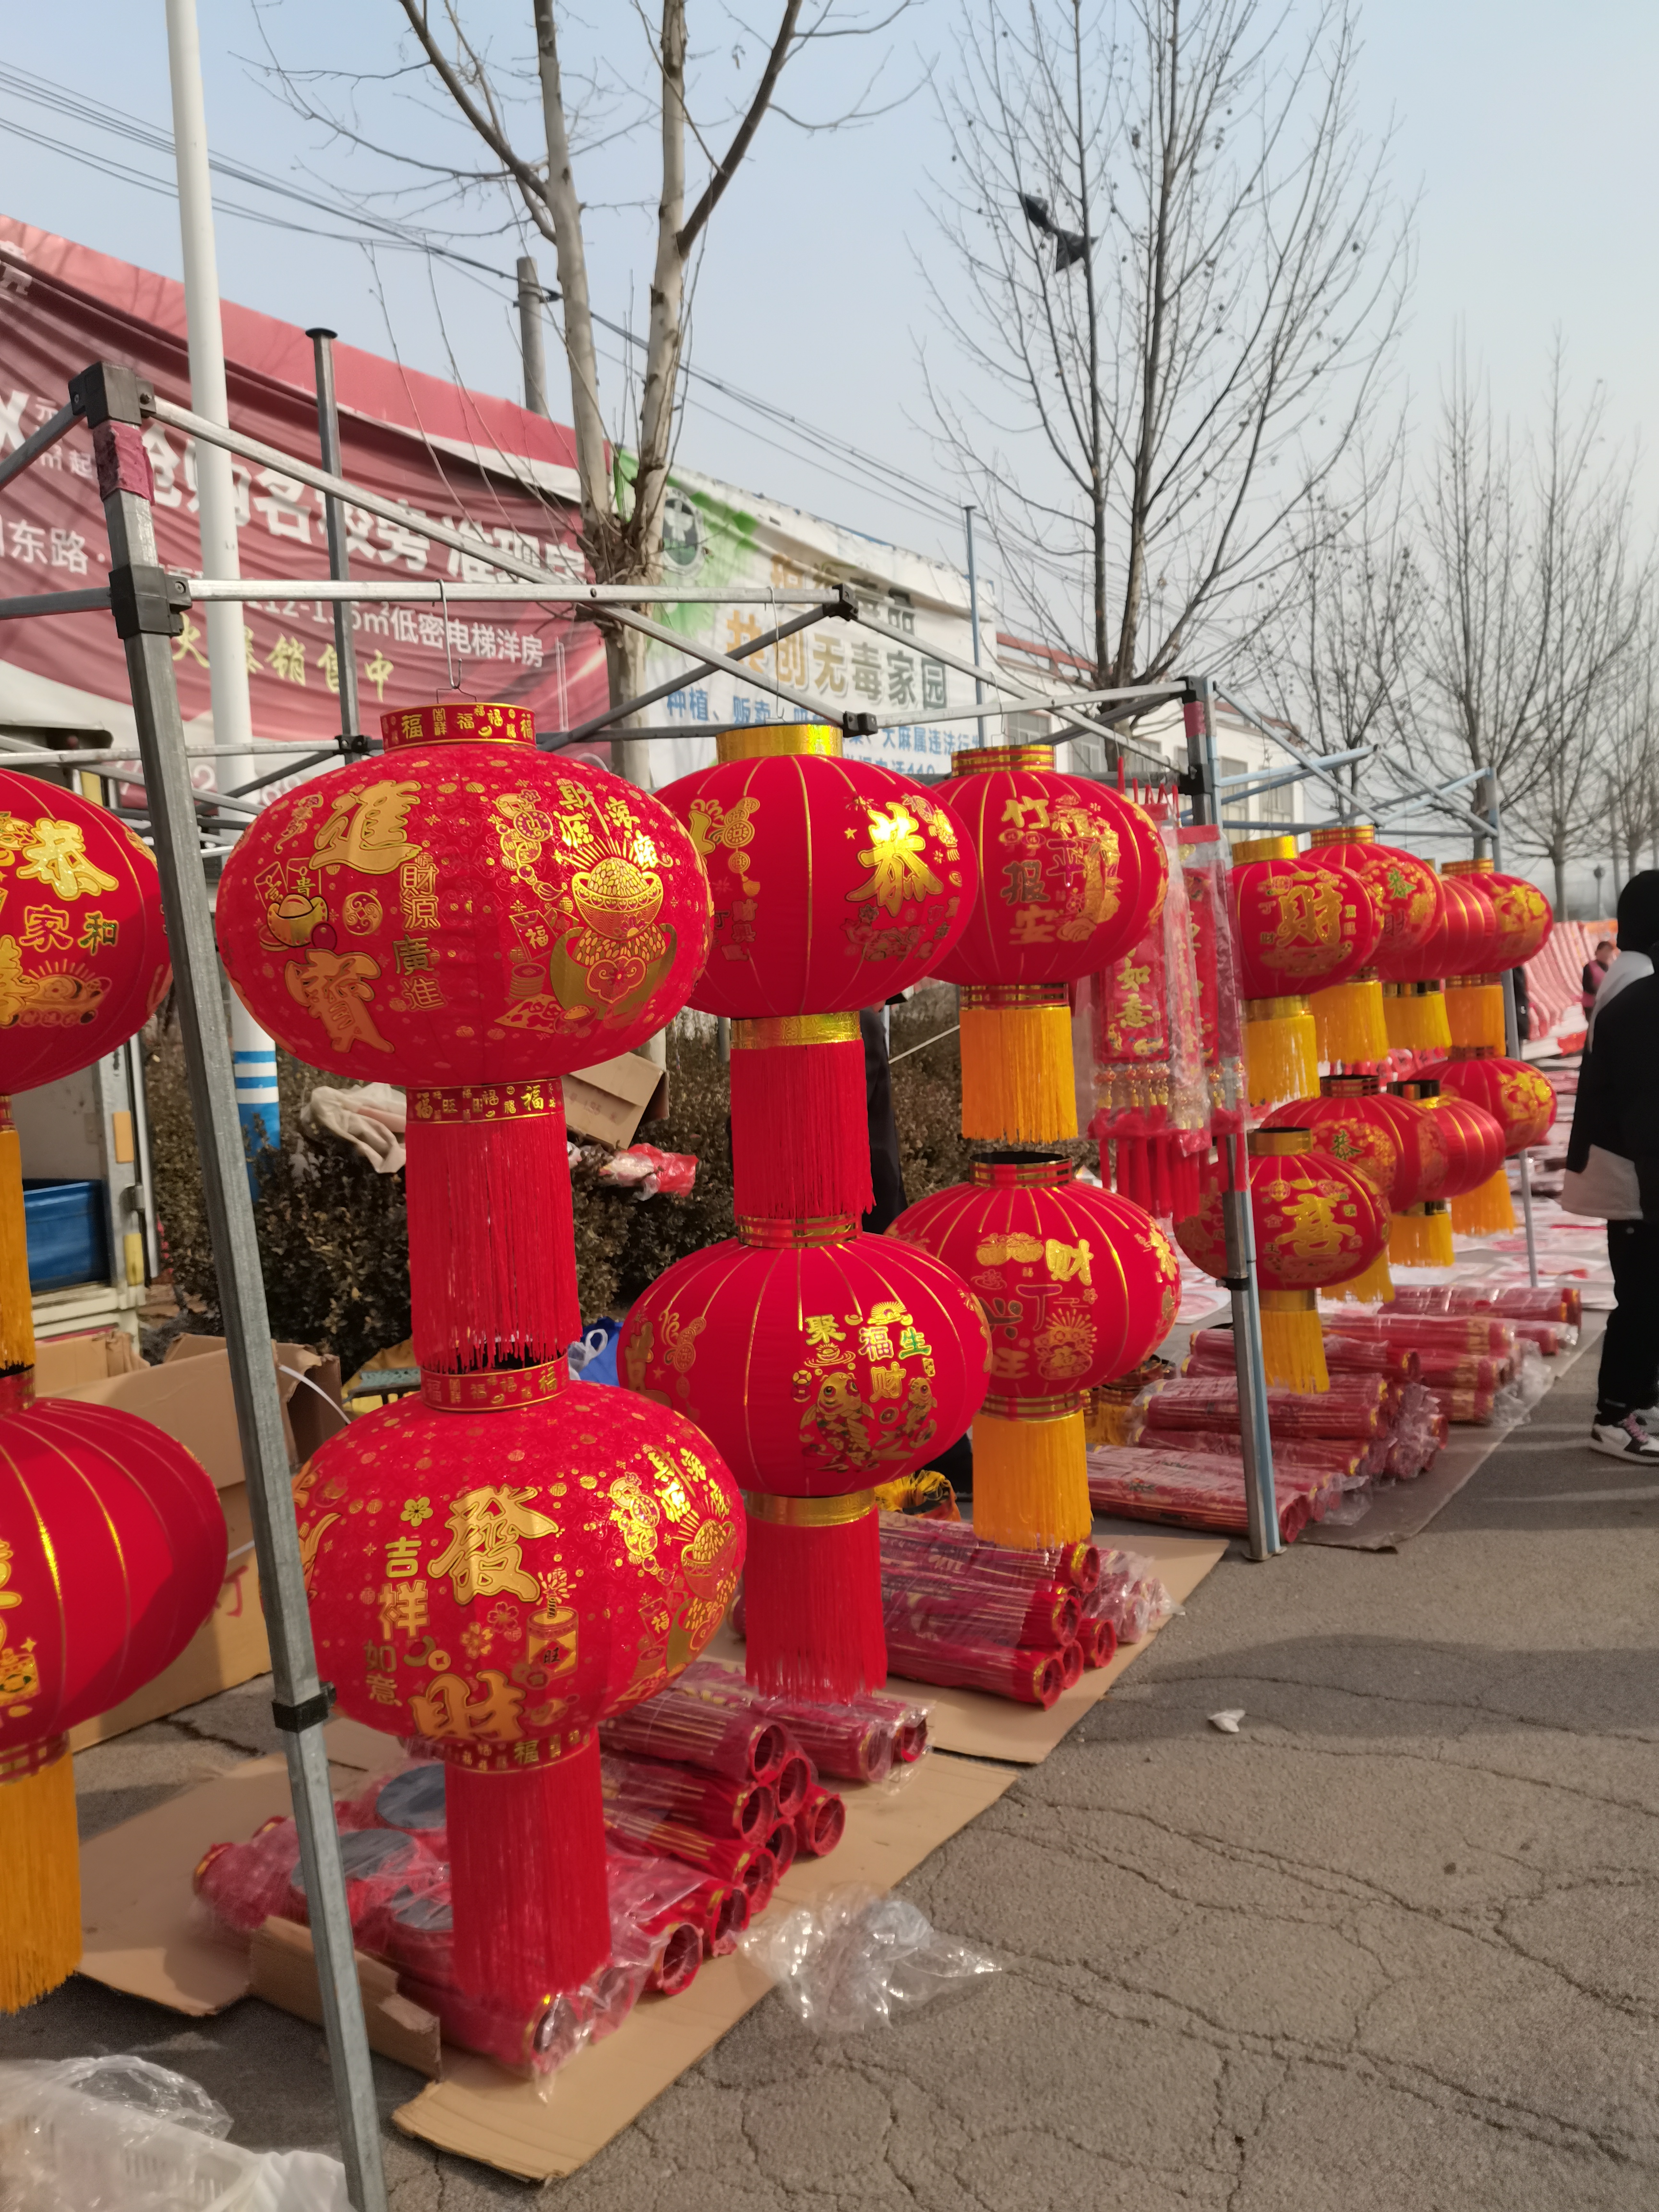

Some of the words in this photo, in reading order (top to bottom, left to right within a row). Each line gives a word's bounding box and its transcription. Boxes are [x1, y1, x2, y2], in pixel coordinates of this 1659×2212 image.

[726, 610, 948, 709] 共创无毒家园
[401, 714, 423, 739] 福
[525, 925, 550, 948] 福
[521, 1084, 544, 1111] 福
[538, 1366, 558, 1394] 福
[543, 1648, 561, 1665] 旺
[514, 1740, 539, 1765] 福
